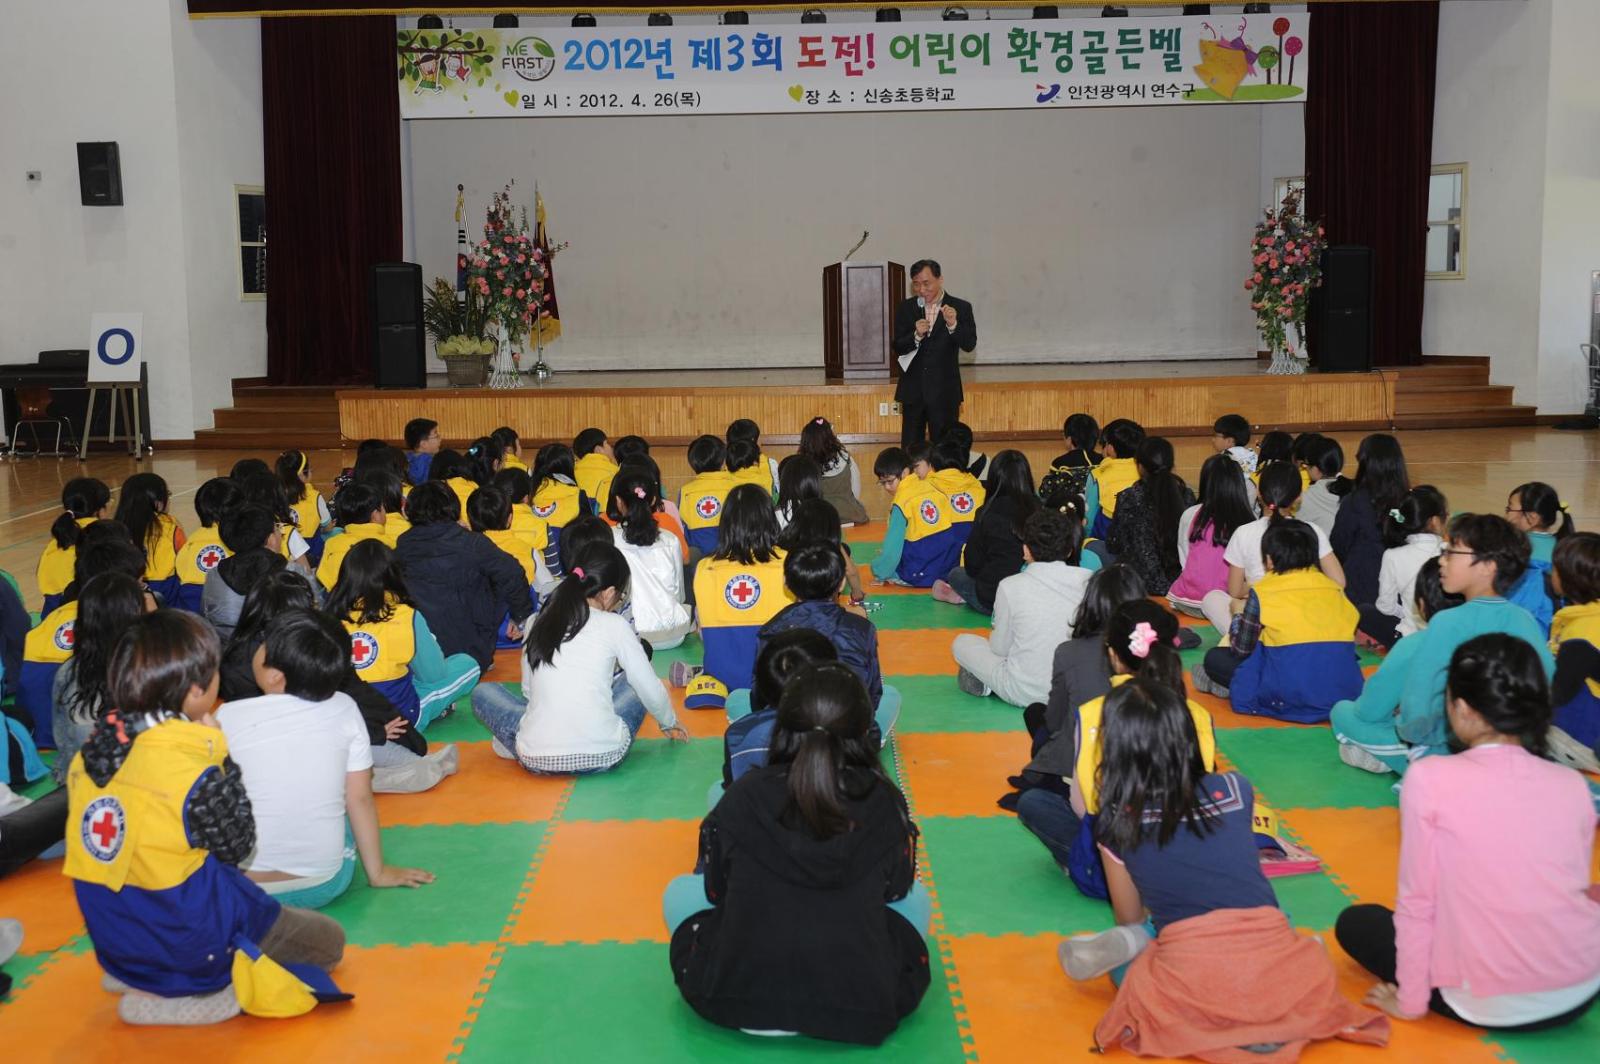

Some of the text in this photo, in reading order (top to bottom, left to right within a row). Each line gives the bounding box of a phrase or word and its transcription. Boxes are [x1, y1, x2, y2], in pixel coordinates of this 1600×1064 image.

[506, 44, 529, 56] ME
[563, 26, 1184, 80] 2012년 제3회 도전! 어린이 환경골든벨
[502, 57, 544, 69] FIRST
[521, 94, 536, 109] 일
[543, 94, 558, 109] 시
[579, 93, 624, 108] 2012.
[630, 93, 647, 107] 4.
[654, 91, 701, 109] 26(목)
[805, 89, 820, 105] 장
[826, 89, 842, 104] 소
[863, 86, 956, 104] 신송초등학교
[1068, 83, 1196, 100] 인천광역시 연수구
